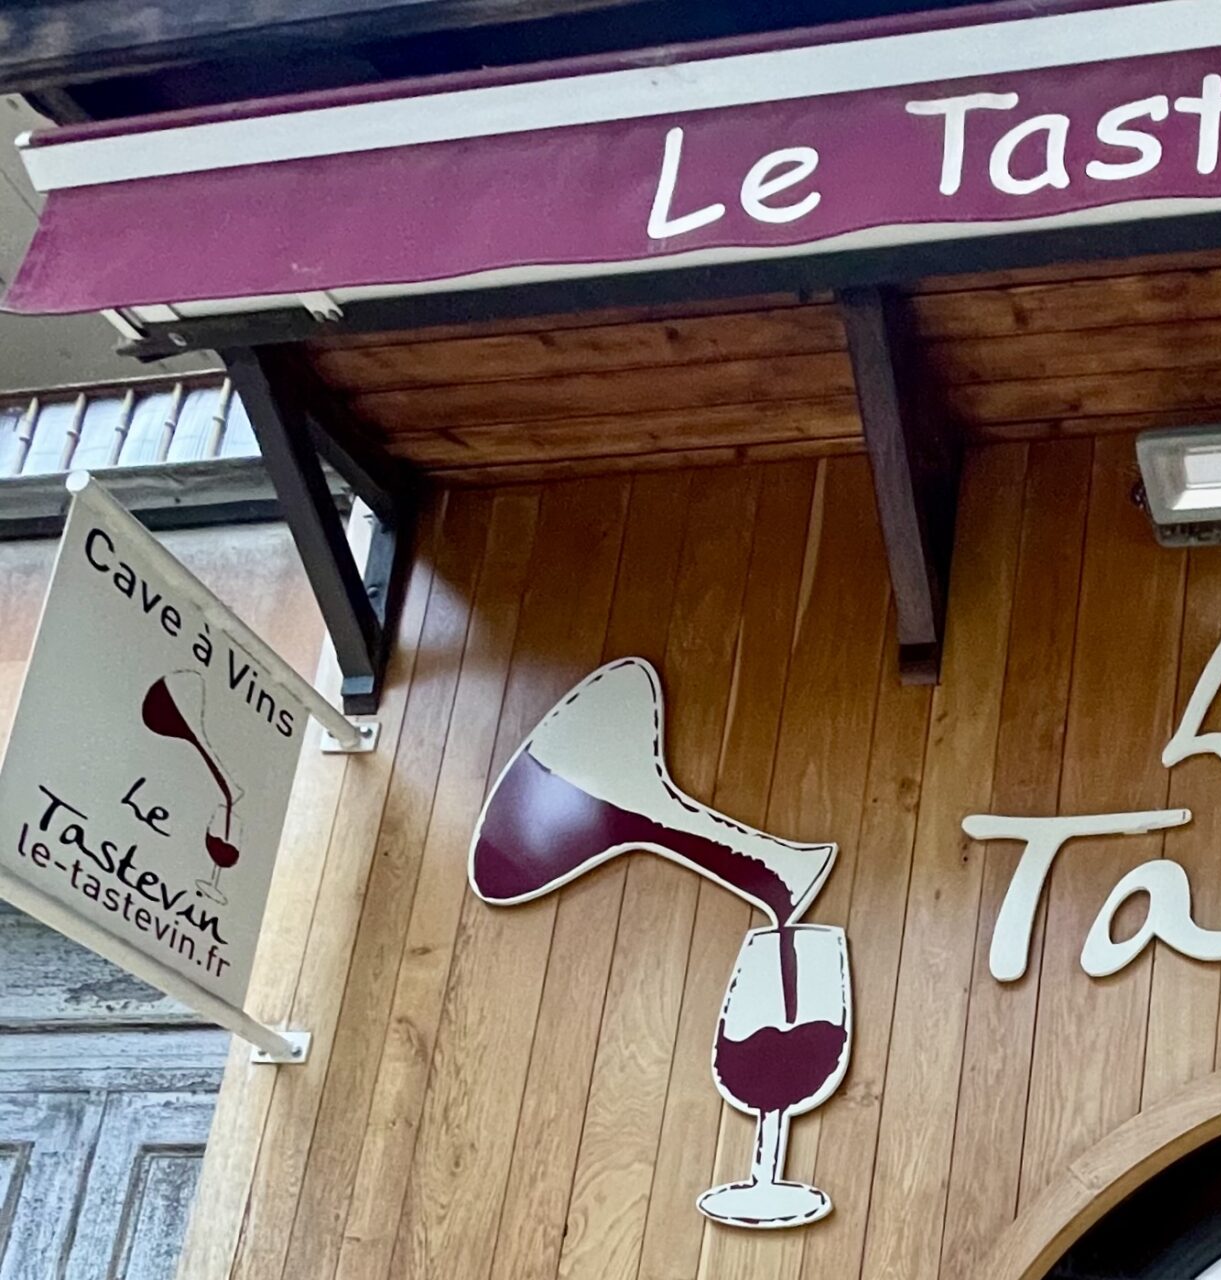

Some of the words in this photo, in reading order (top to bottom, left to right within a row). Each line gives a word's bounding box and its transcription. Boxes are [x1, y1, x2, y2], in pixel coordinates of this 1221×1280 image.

[648, 127, 820, 239] Le
[85, 528, 181, 637] Cave
[193, 623, 212, 667] à
[229, 649, 294, 738] Vins
[39, 785, 228, 945] Tastevin
[121, 777, 170, 837] Le
[18, 824, 230, 977] le-tastevin.fr
